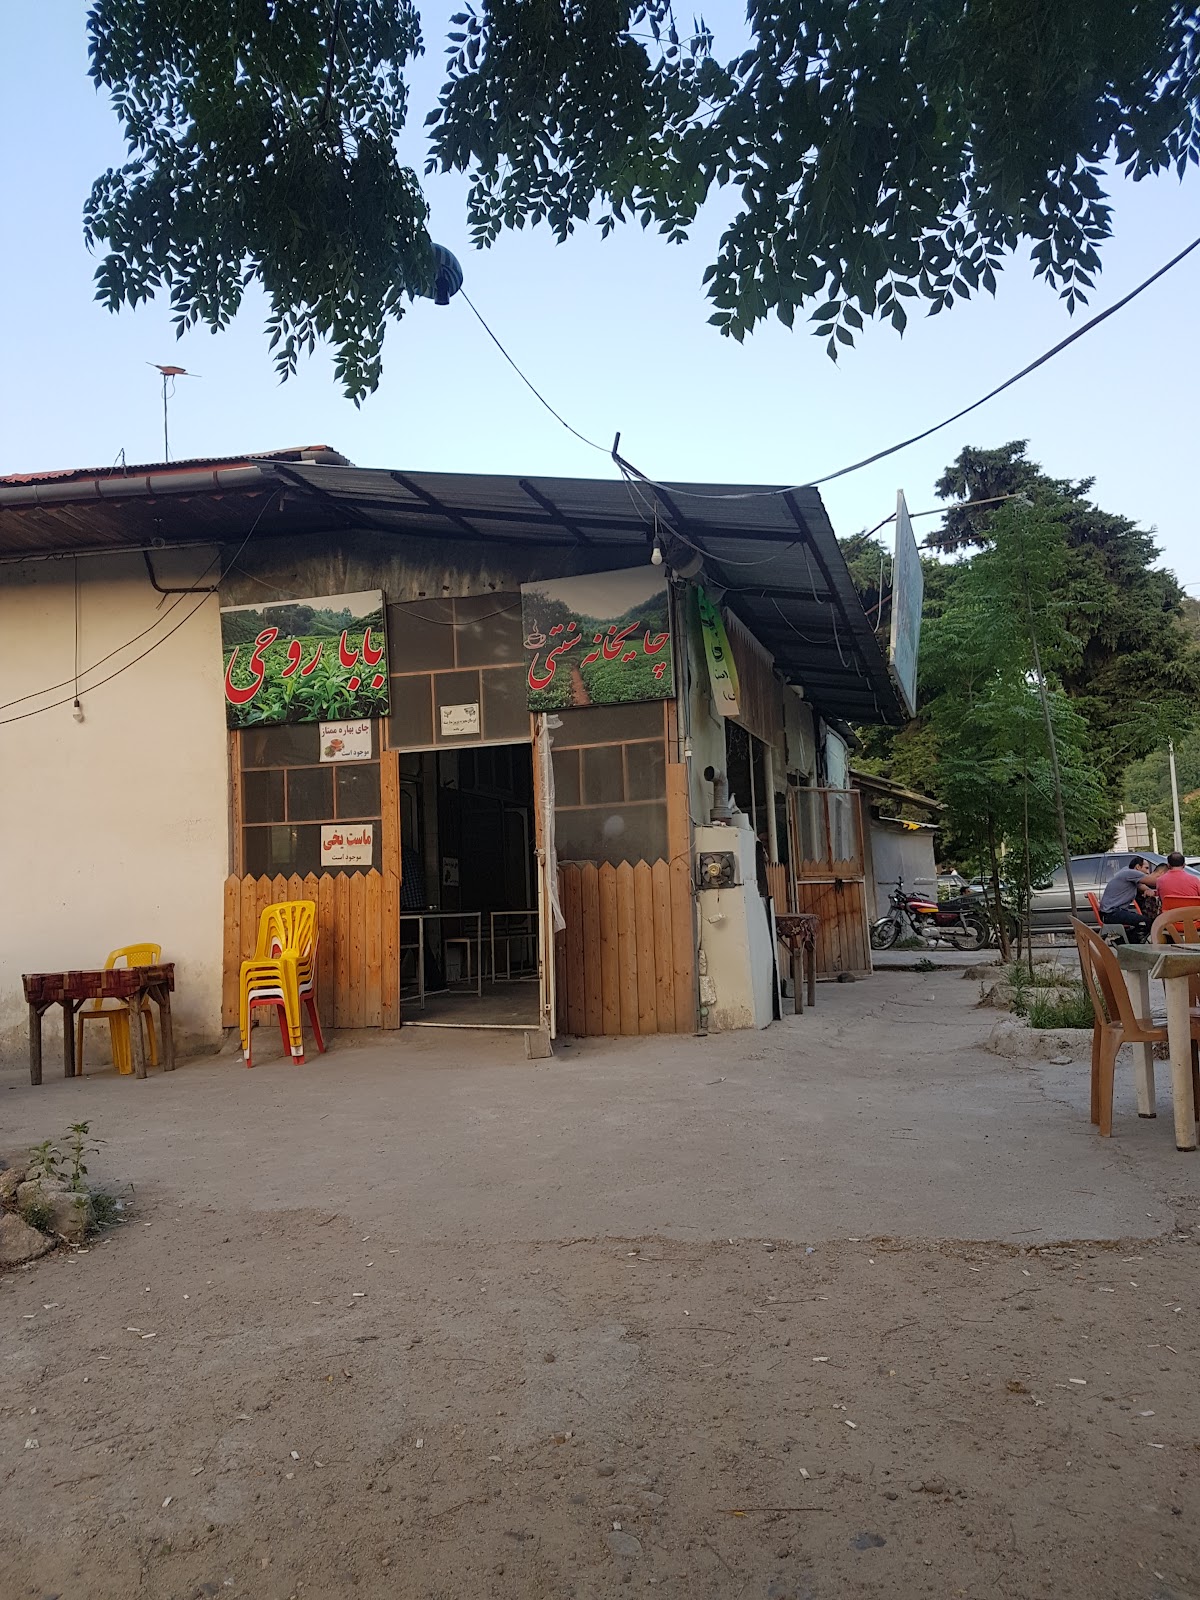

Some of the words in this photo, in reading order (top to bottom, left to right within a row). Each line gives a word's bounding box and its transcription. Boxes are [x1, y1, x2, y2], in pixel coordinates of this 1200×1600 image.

[225, 627, 324, 705] روحی
[339, 627, 385, 692] بابا
[528, 622, 582, 690] سنتی
[580, 621, 670, 679] چایخانه
[341, 749, 352, 757] است
[353, 750, 369, 758] موجود
[323, 830, 344, 851] یخی
[346, 829, 372, 846] ماست
